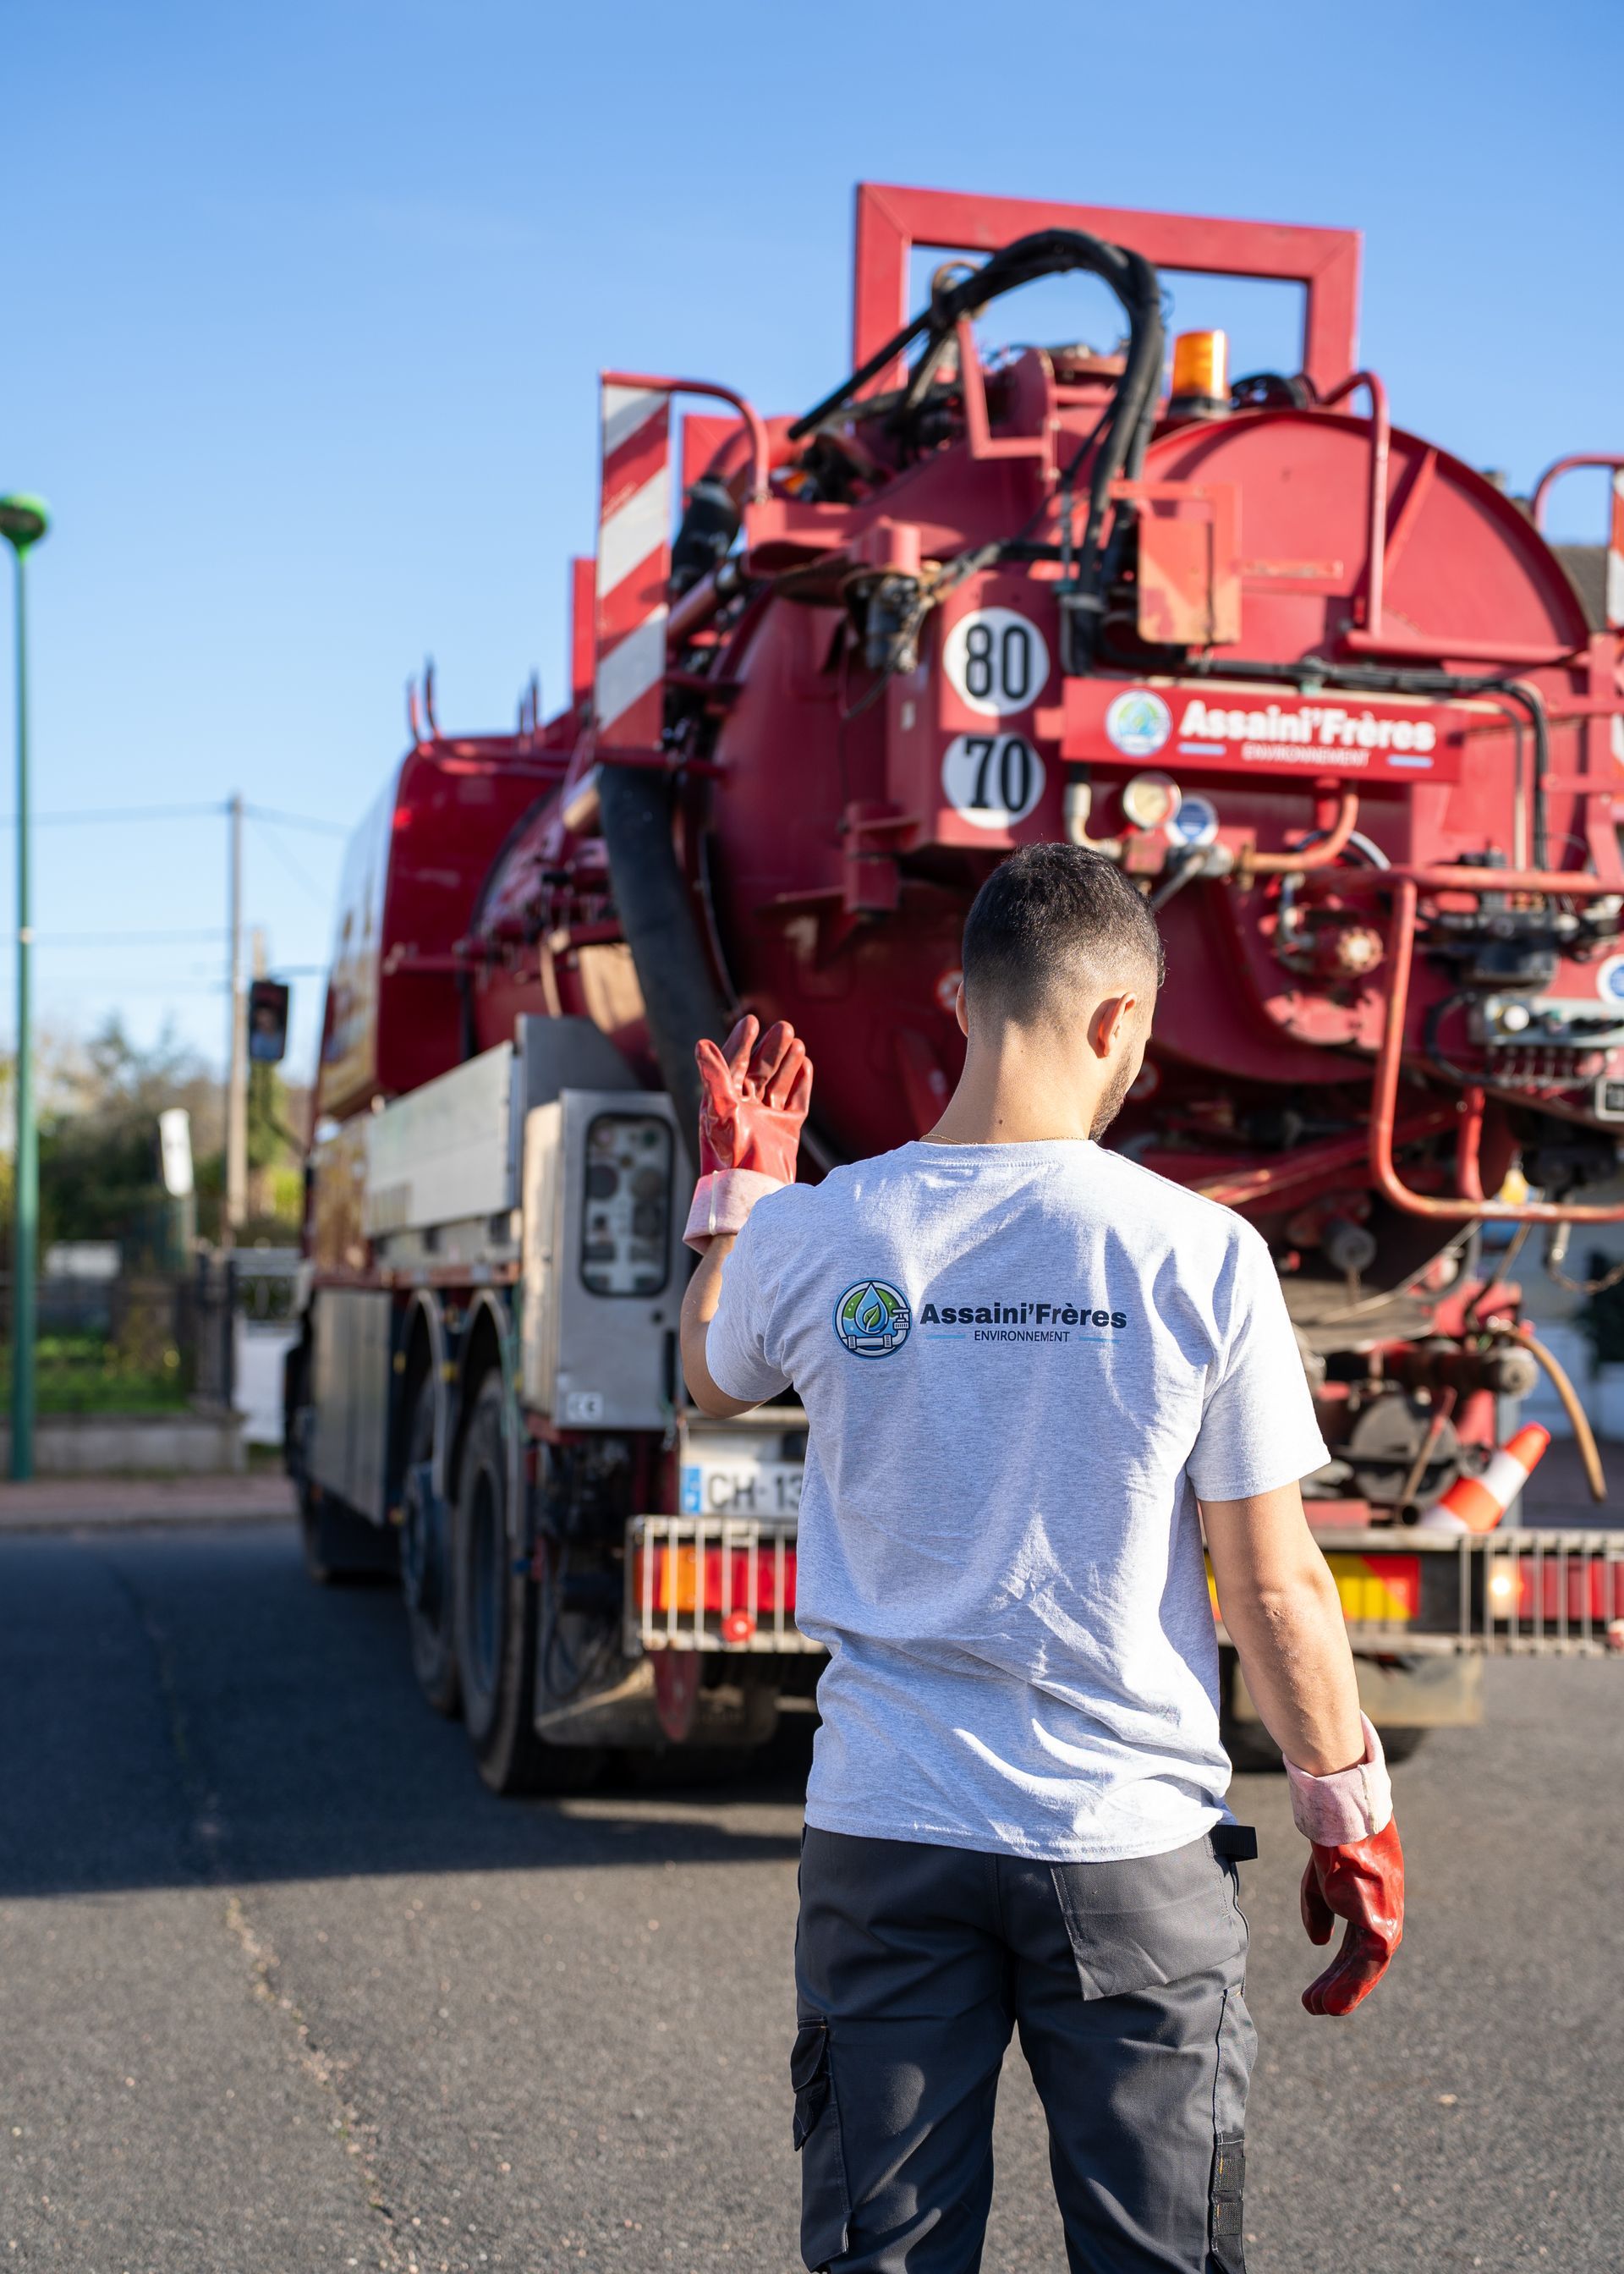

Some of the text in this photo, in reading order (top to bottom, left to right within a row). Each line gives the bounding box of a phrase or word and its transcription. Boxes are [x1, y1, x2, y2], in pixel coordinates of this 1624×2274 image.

[966, 623, 1029, 701] 80
[964, 738, 1030, 812] 70
[1241, 742, 1371, 766] ENVIRONNEMENT
[974, 1330, 1070, 1343] ENVIRONNEMENT
